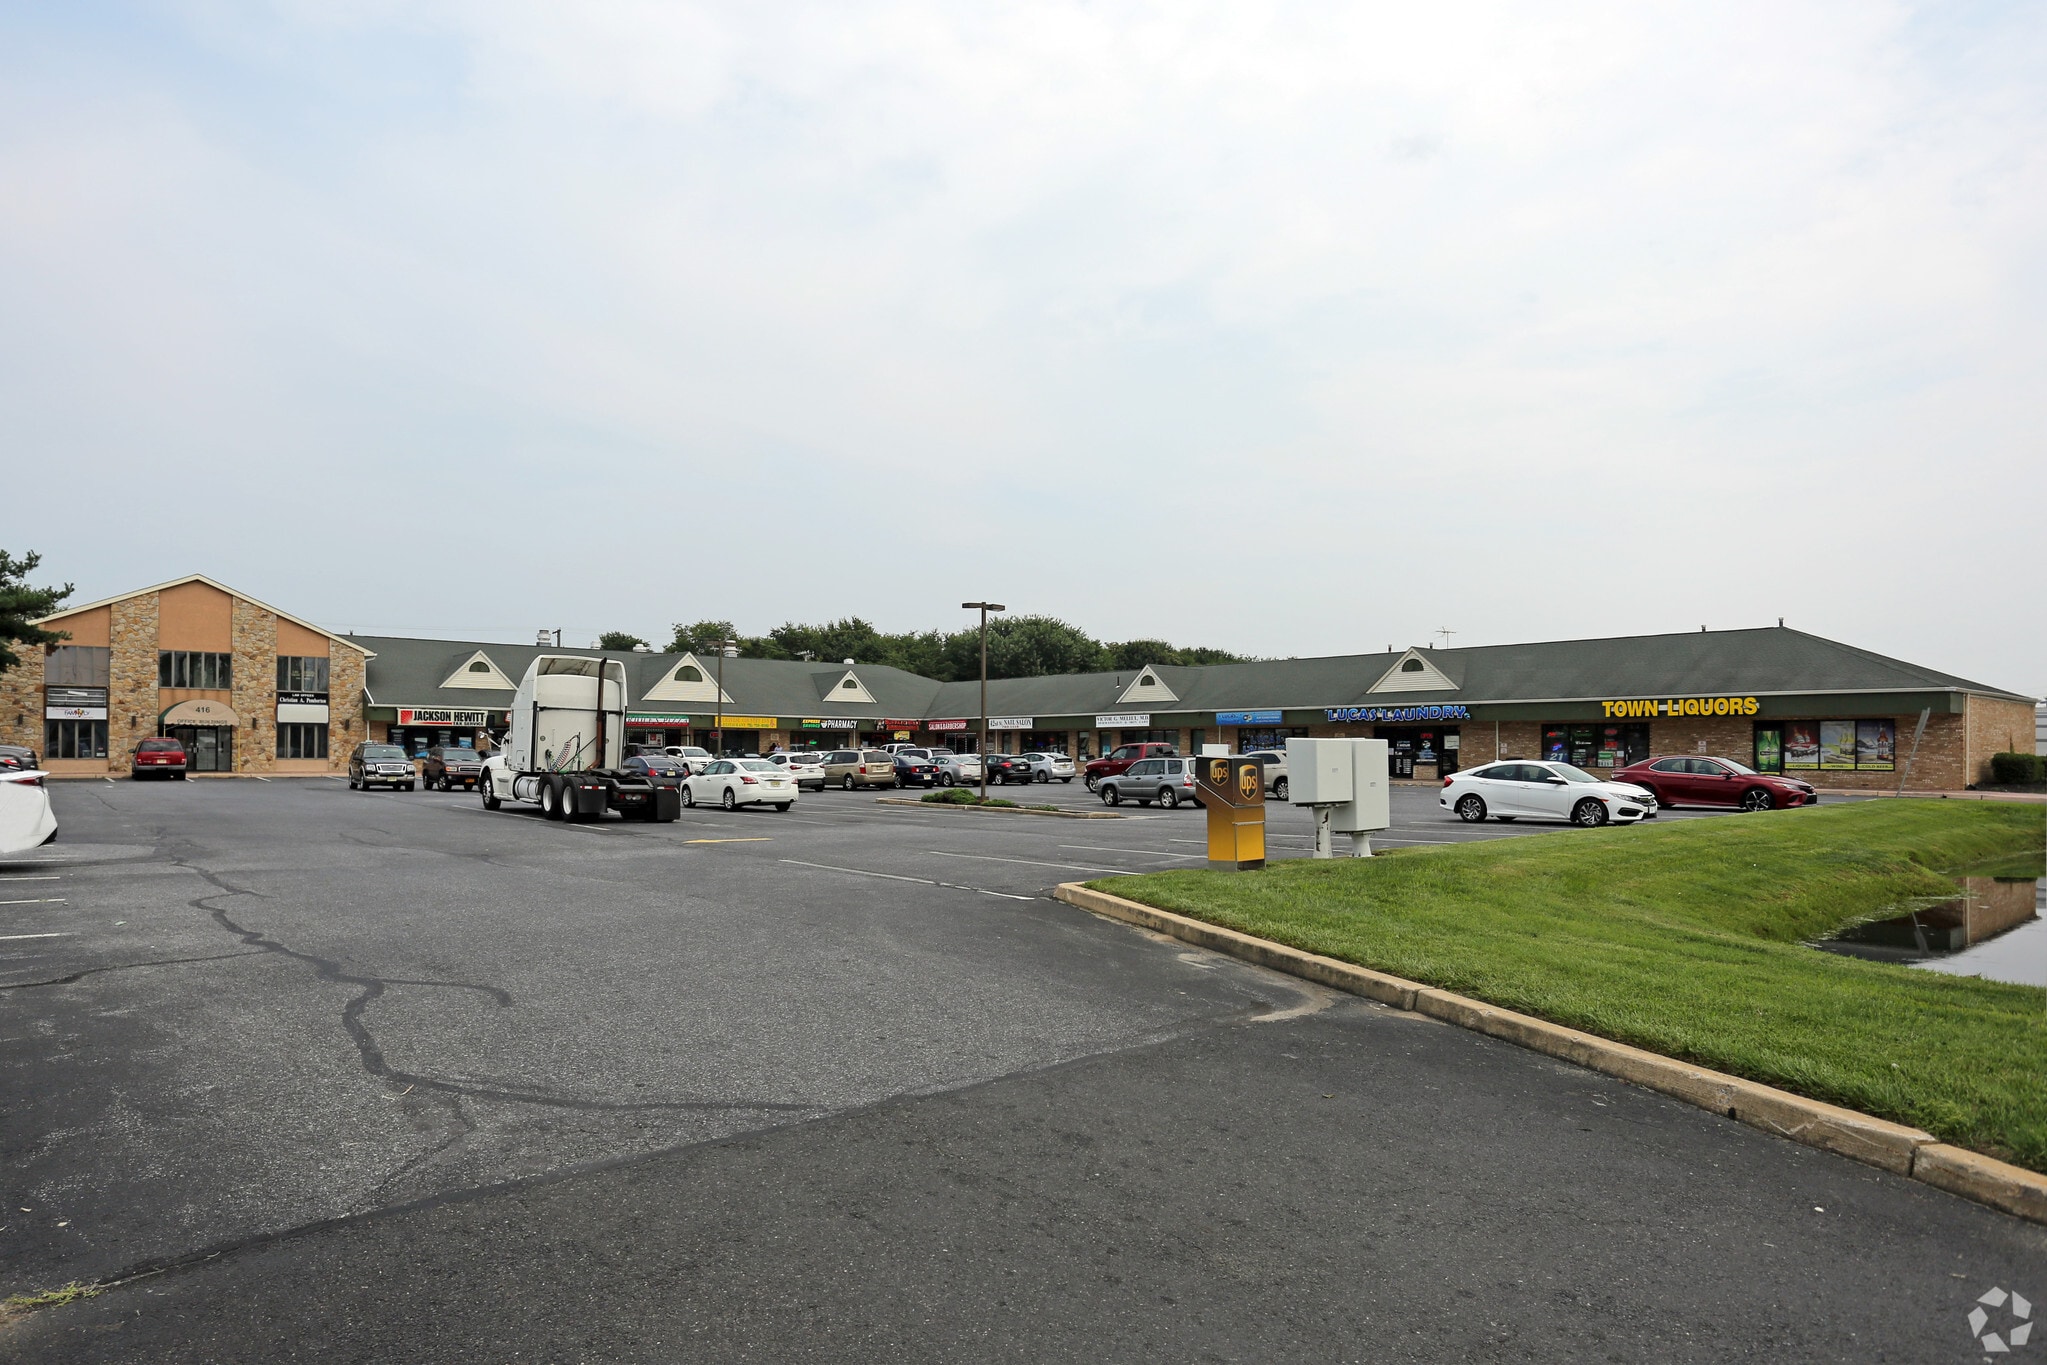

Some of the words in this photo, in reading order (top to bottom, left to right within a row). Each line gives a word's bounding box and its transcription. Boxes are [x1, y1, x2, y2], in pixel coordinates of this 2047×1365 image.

[1382, 704, 1467, 722] LAUNDRY
[1602, 700, 1658, 717] TOWN
[1667, 697, 1758, 717] LIQUORS
[413, 710, 452, 721] JACKSON
[454, 711, 485, 722] HEWITT
[827, 719, 858, 729] PHARMACY
[1212, 767, 1228, 782] ups
[1241, 775, 1258, 795] ups
